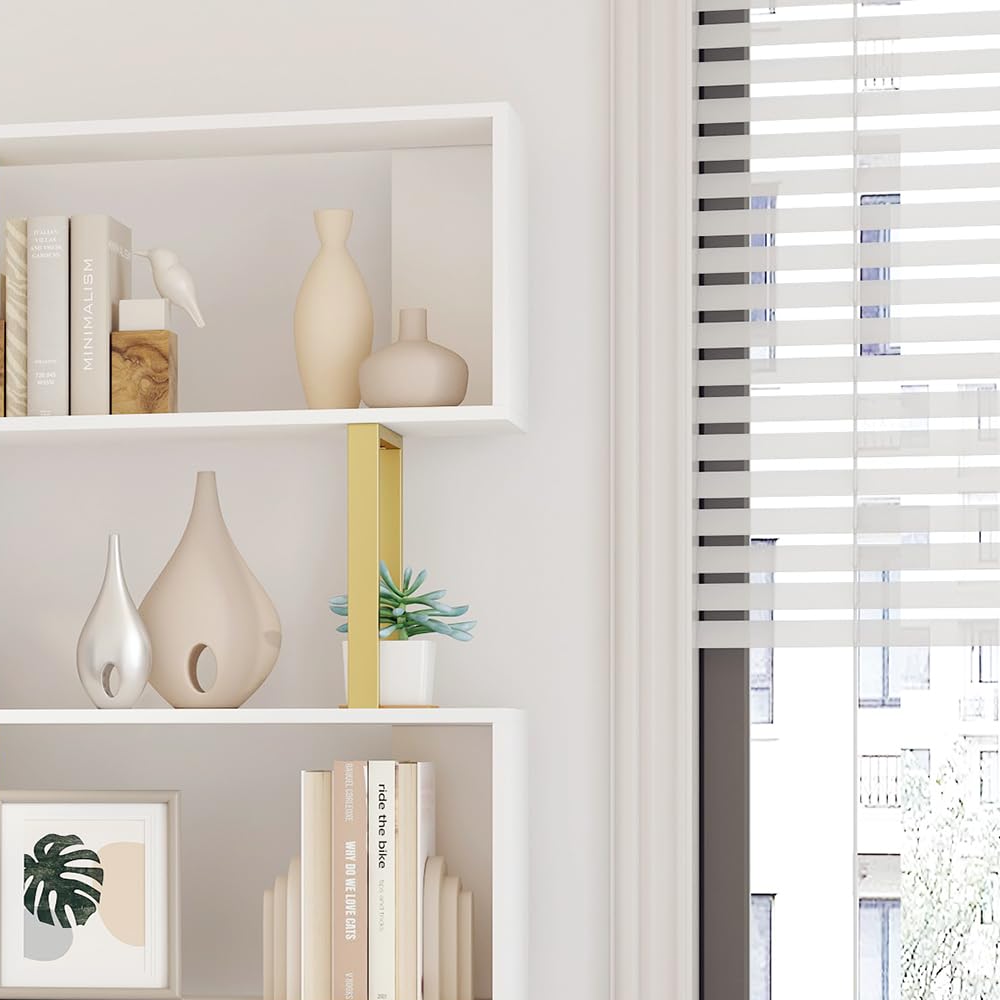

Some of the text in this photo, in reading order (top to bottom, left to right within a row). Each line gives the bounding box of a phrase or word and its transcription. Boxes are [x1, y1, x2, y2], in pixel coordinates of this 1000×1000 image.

[83, 258, 94, 371] MINIMALISM
[378, 783, 387, 869] ride the bike
[345, 841, 356, 940] WHY DO WE LOVE CATS
